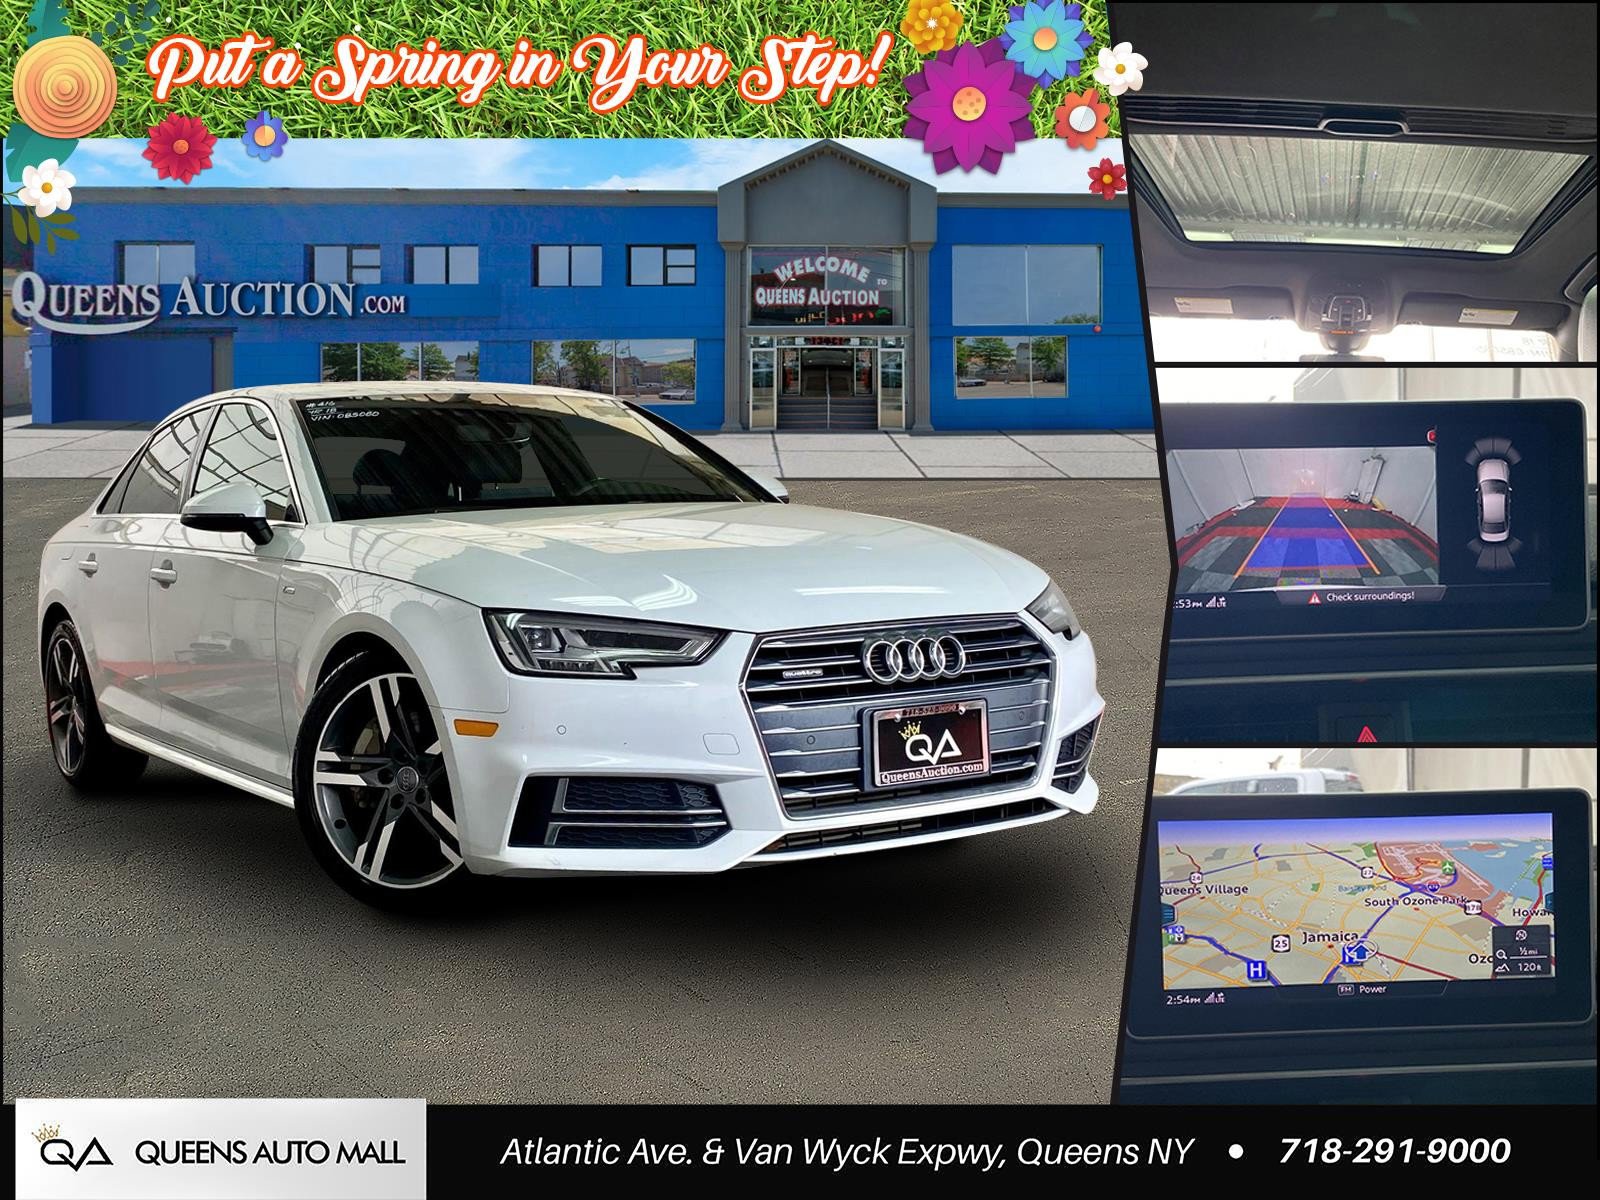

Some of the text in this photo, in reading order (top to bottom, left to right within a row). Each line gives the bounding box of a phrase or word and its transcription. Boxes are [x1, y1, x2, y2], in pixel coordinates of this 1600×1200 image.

[774, 256, 872, 284] WELCOME
[12, 271, 161, 335] QUEENS
[755, 287, 879, 306] QUEENS AUCTION
[1326, 591, 1415, 602] Check surroundings!
[905, 728, 963, 766] QA
[881, 761, 984, 785] QueensAuction.com
[1206, 884, 1249, 897] Village
[1364, 895, 1467, 907] South Ozone Park
[1275, 940, 1288, 949] 25
[1302, 930, 1359, 945] Jamaica
[1359, 984, 1387, 994] Power
